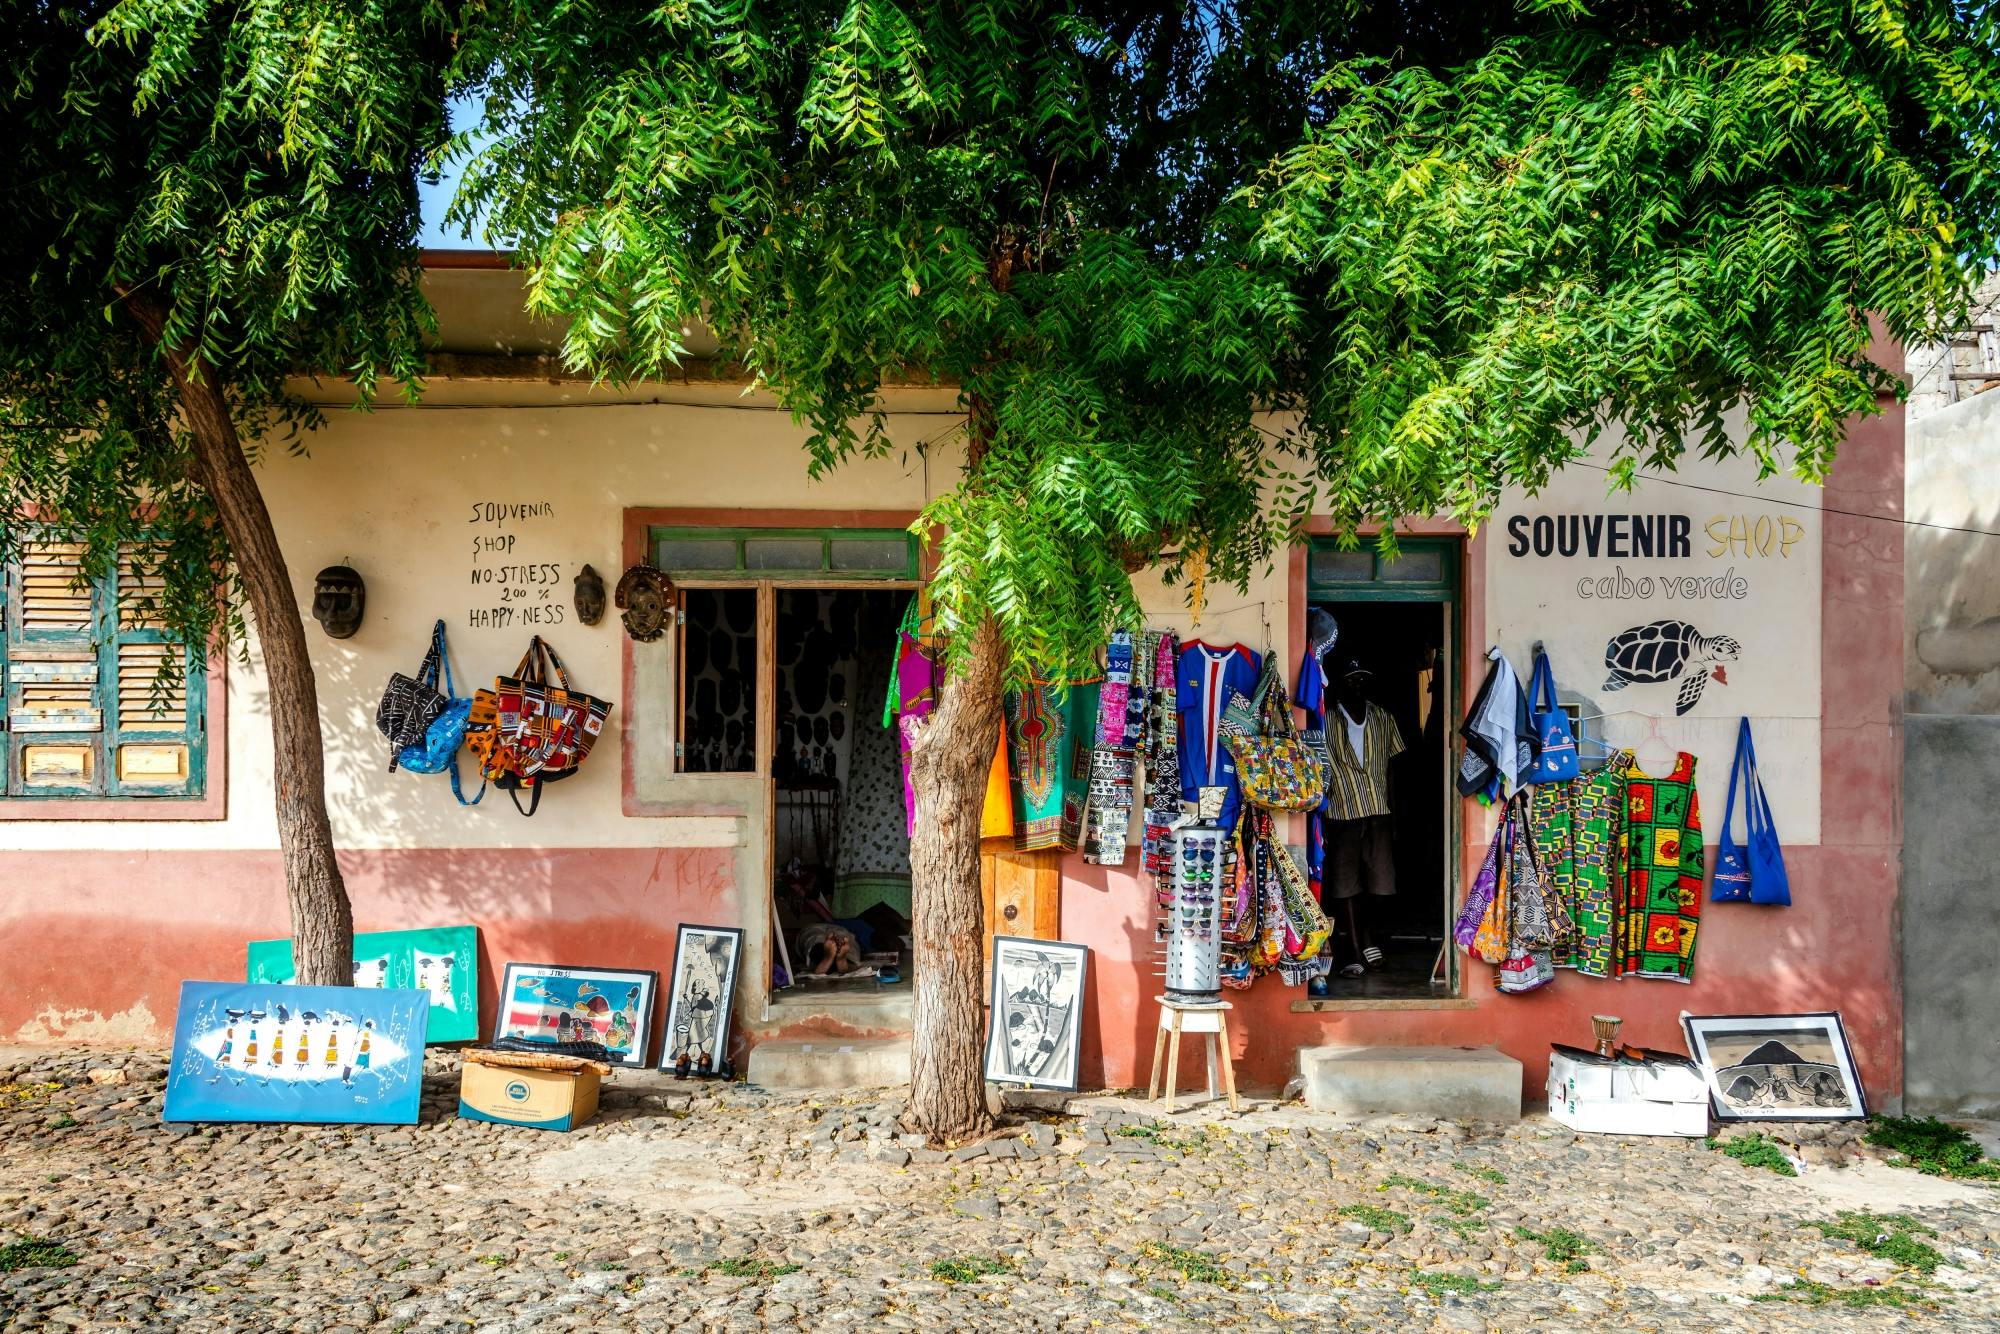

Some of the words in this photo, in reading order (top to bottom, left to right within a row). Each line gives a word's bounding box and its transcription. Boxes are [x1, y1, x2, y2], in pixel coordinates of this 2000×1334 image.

[472, 535, 516, 563] SHOP
[1507, 514, 1691, 558] SOUVENIR
[1704, 513, 1806, 559] SHOP
[501, 587, 527, 601] 200
[1577, 565, 1655, 600] cabo
[1660, 566, 1748, 600] verde
